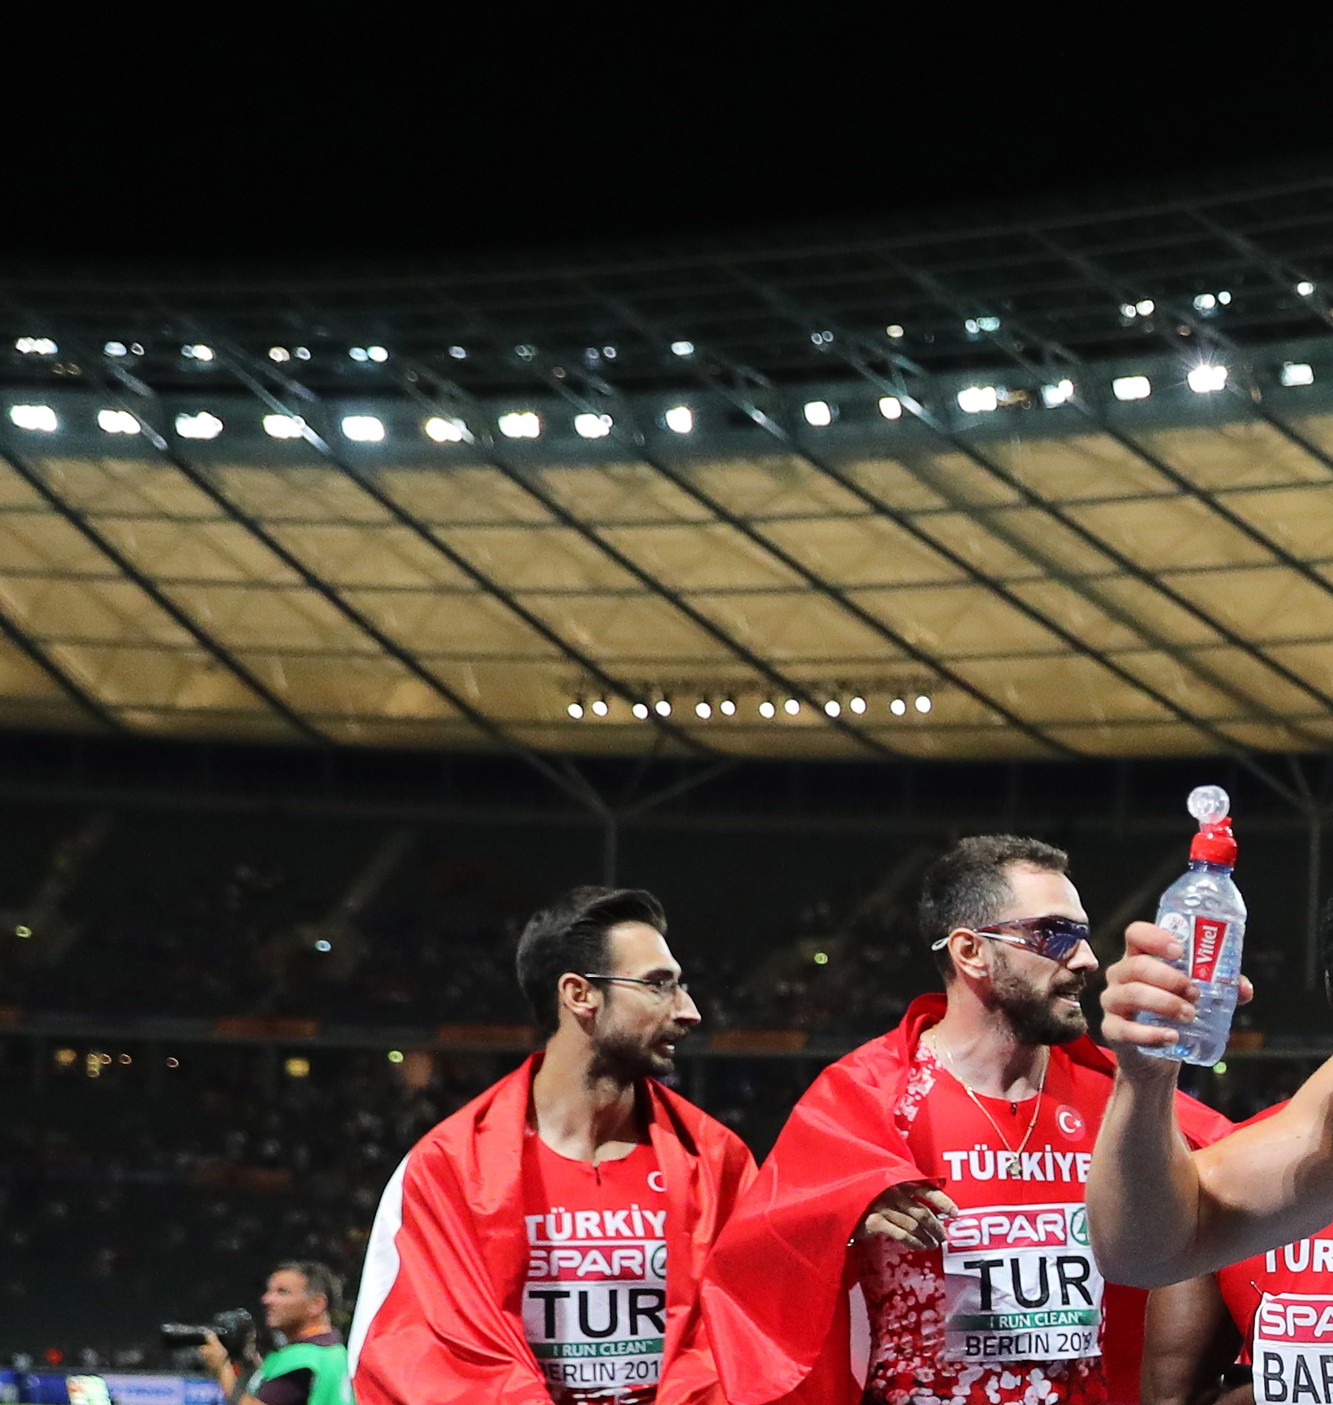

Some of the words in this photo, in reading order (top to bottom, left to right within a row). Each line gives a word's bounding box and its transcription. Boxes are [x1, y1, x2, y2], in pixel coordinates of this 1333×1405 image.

[1195, 925, 1219, 965] Vittel
[942, 1144, 1092, 1183] TÜRKİYE
[524, 1203, 667, 1241] TÜRKİY
[948, 1212, 1067, 1248] SPAR
[528, 1249, 644, 1277] SPAR
[963, 1254, 1094, 1311] TUR
[528, 1287, 666, 1340] TUR
[999, 1313, 1032, 1328] RUN
[562, 1343, 597, 1356] RUN
[966, 1332, 1050, 1357] BERLIN
[540, 1361, 616, 1383] ERLIN
[625, 1360, 663, 1380] 201
